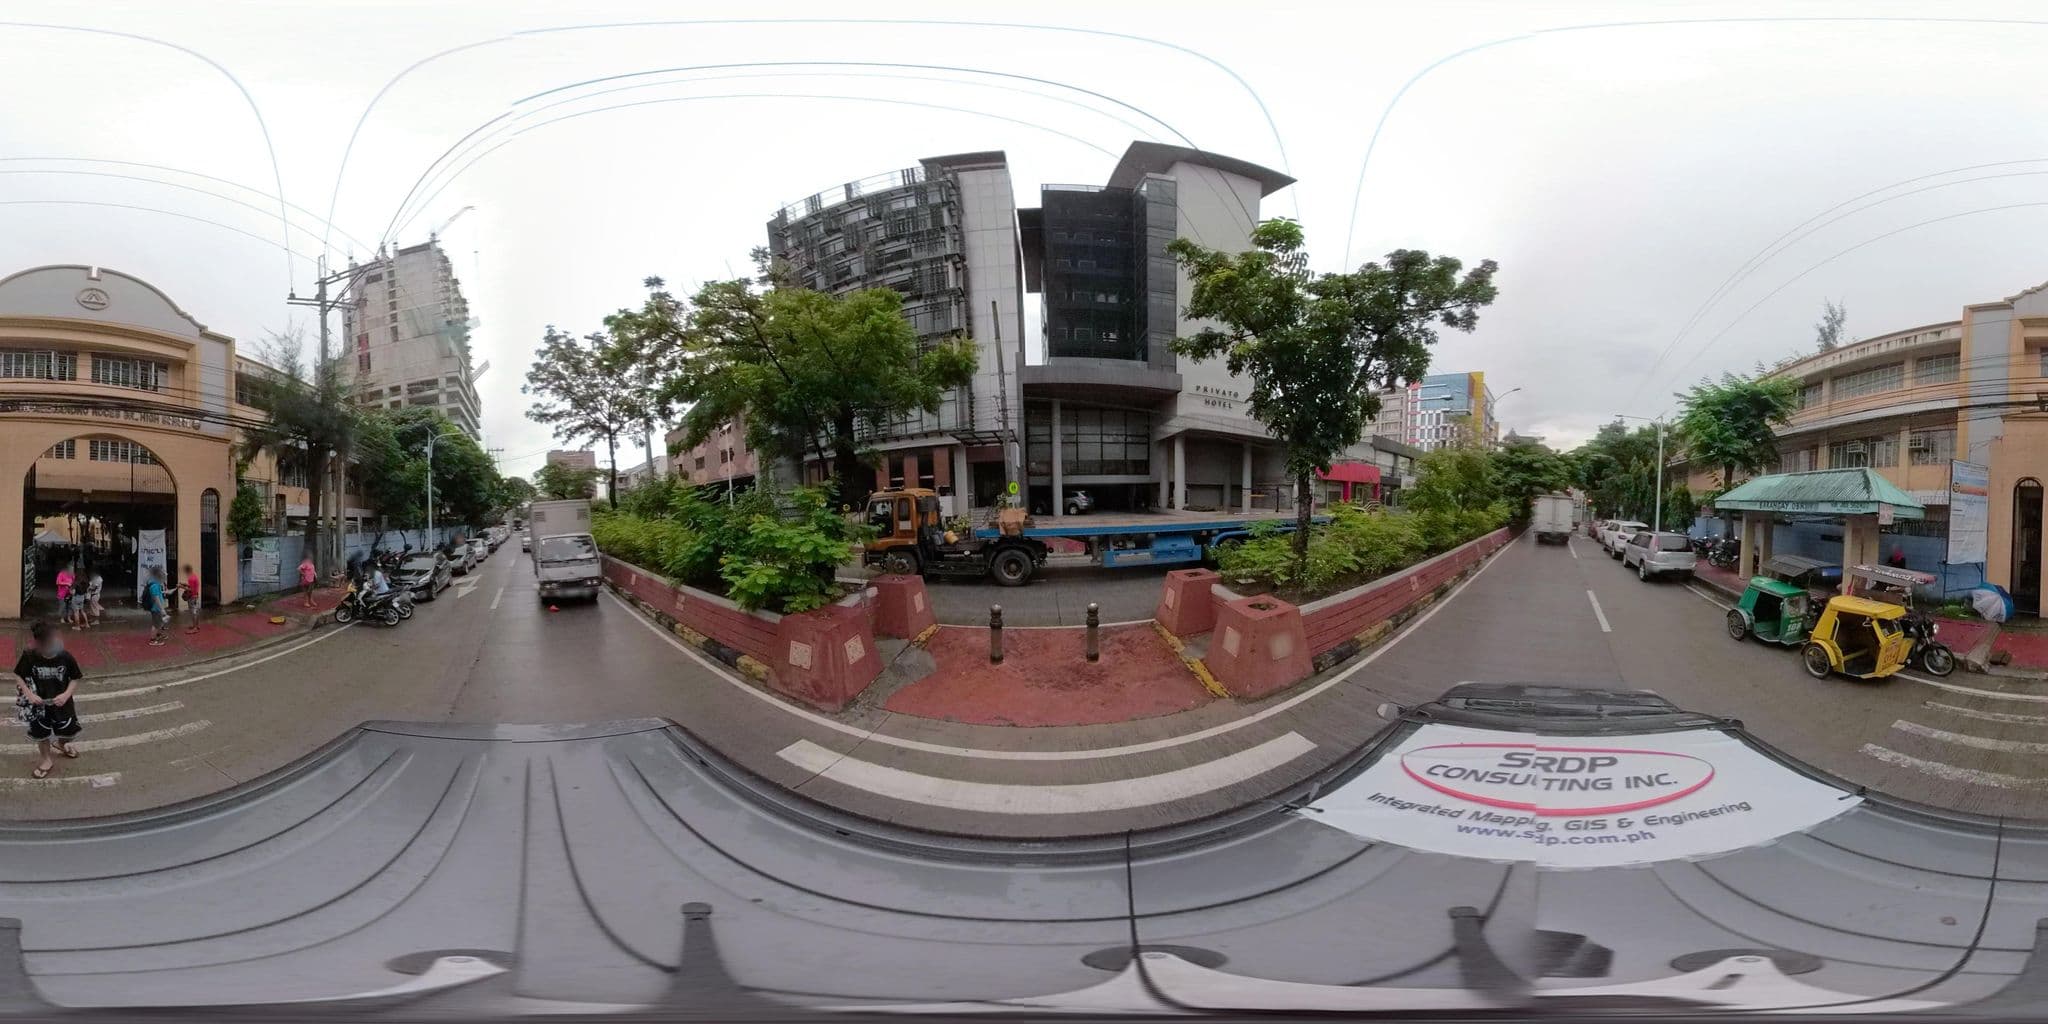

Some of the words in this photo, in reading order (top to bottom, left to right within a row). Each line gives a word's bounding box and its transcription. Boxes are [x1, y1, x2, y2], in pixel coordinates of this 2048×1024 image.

[1195, 385, 1239, 398] PRIVATO
[1204, 398, 1233, 409] HOTEL
[1497, 751, 1619, 774] SRDP
[1625, 772, 1679, 789] INC.
[1367, 792, 1466, 818] Integrated
[1564, 819, 1608, 831] GIS
[1616, 817, 1635, 829] &
[1643, 801, 1752, 826] Engineering
